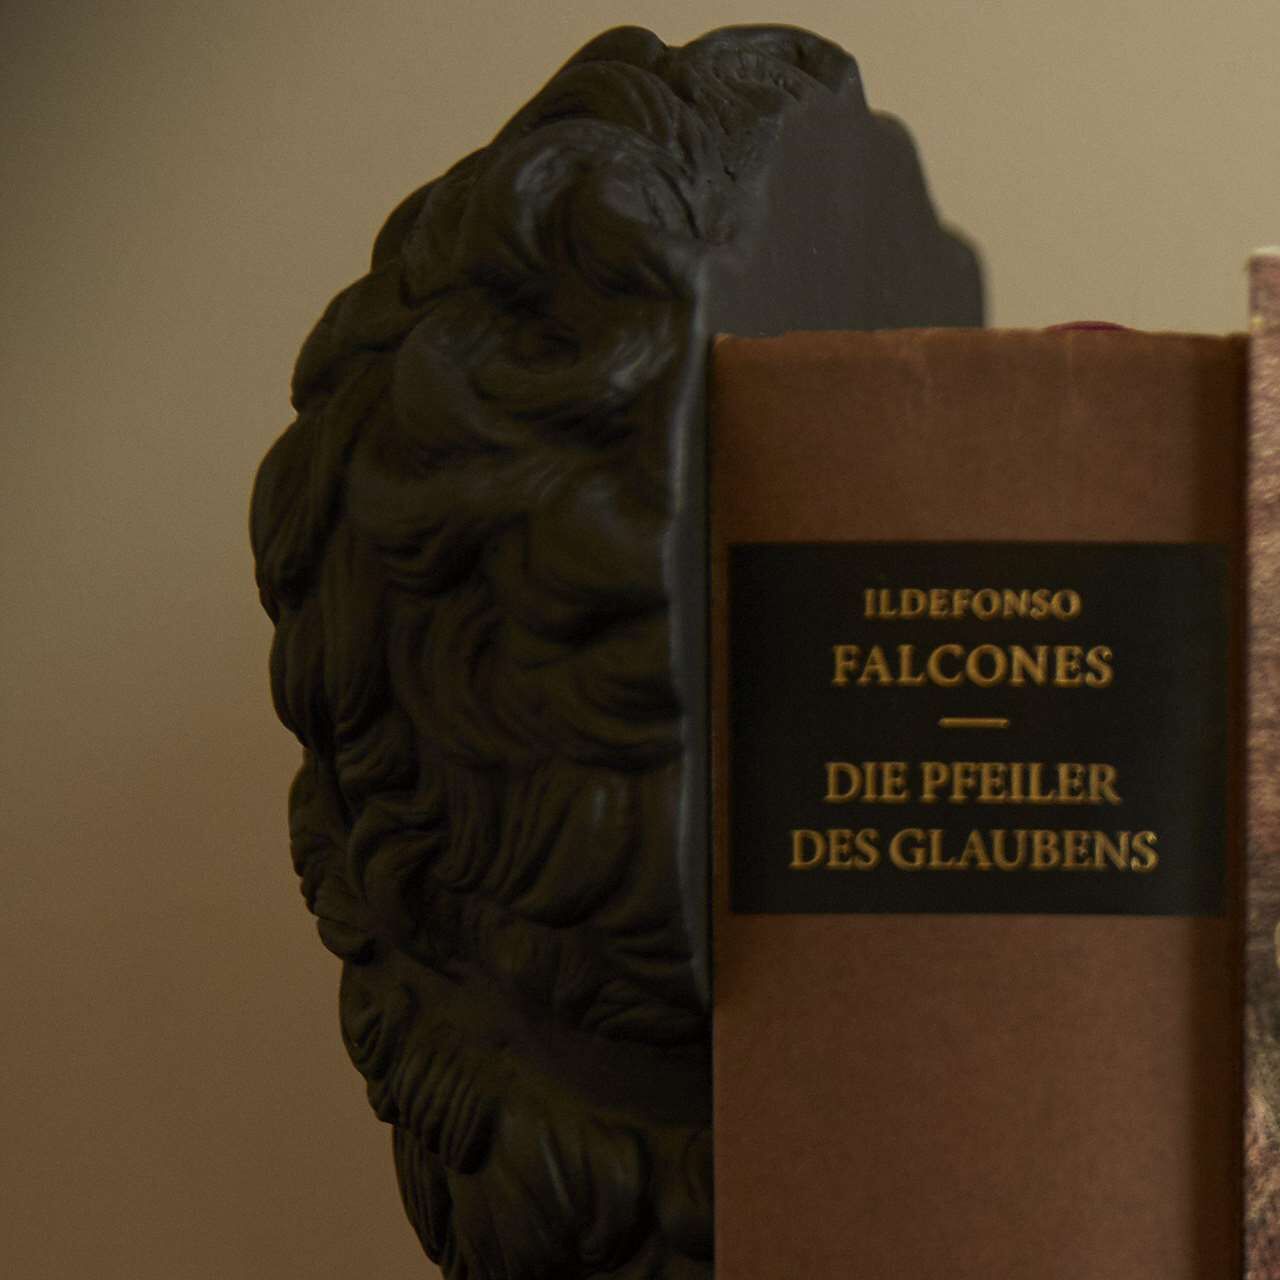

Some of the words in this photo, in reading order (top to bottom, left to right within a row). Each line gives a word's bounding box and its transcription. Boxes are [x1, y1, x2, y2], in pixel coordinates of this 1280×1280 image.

[864, 588, 1082, 620] ILDEFONSO
[832, 643, 1113, 688] FALCONES
[825, 762, 908, 802] DIE
[920, 762, 1122, 804] PFEILER
[789, 828, 880, 870] DES
[888, 829, 1160, 873] GLAUBENS
